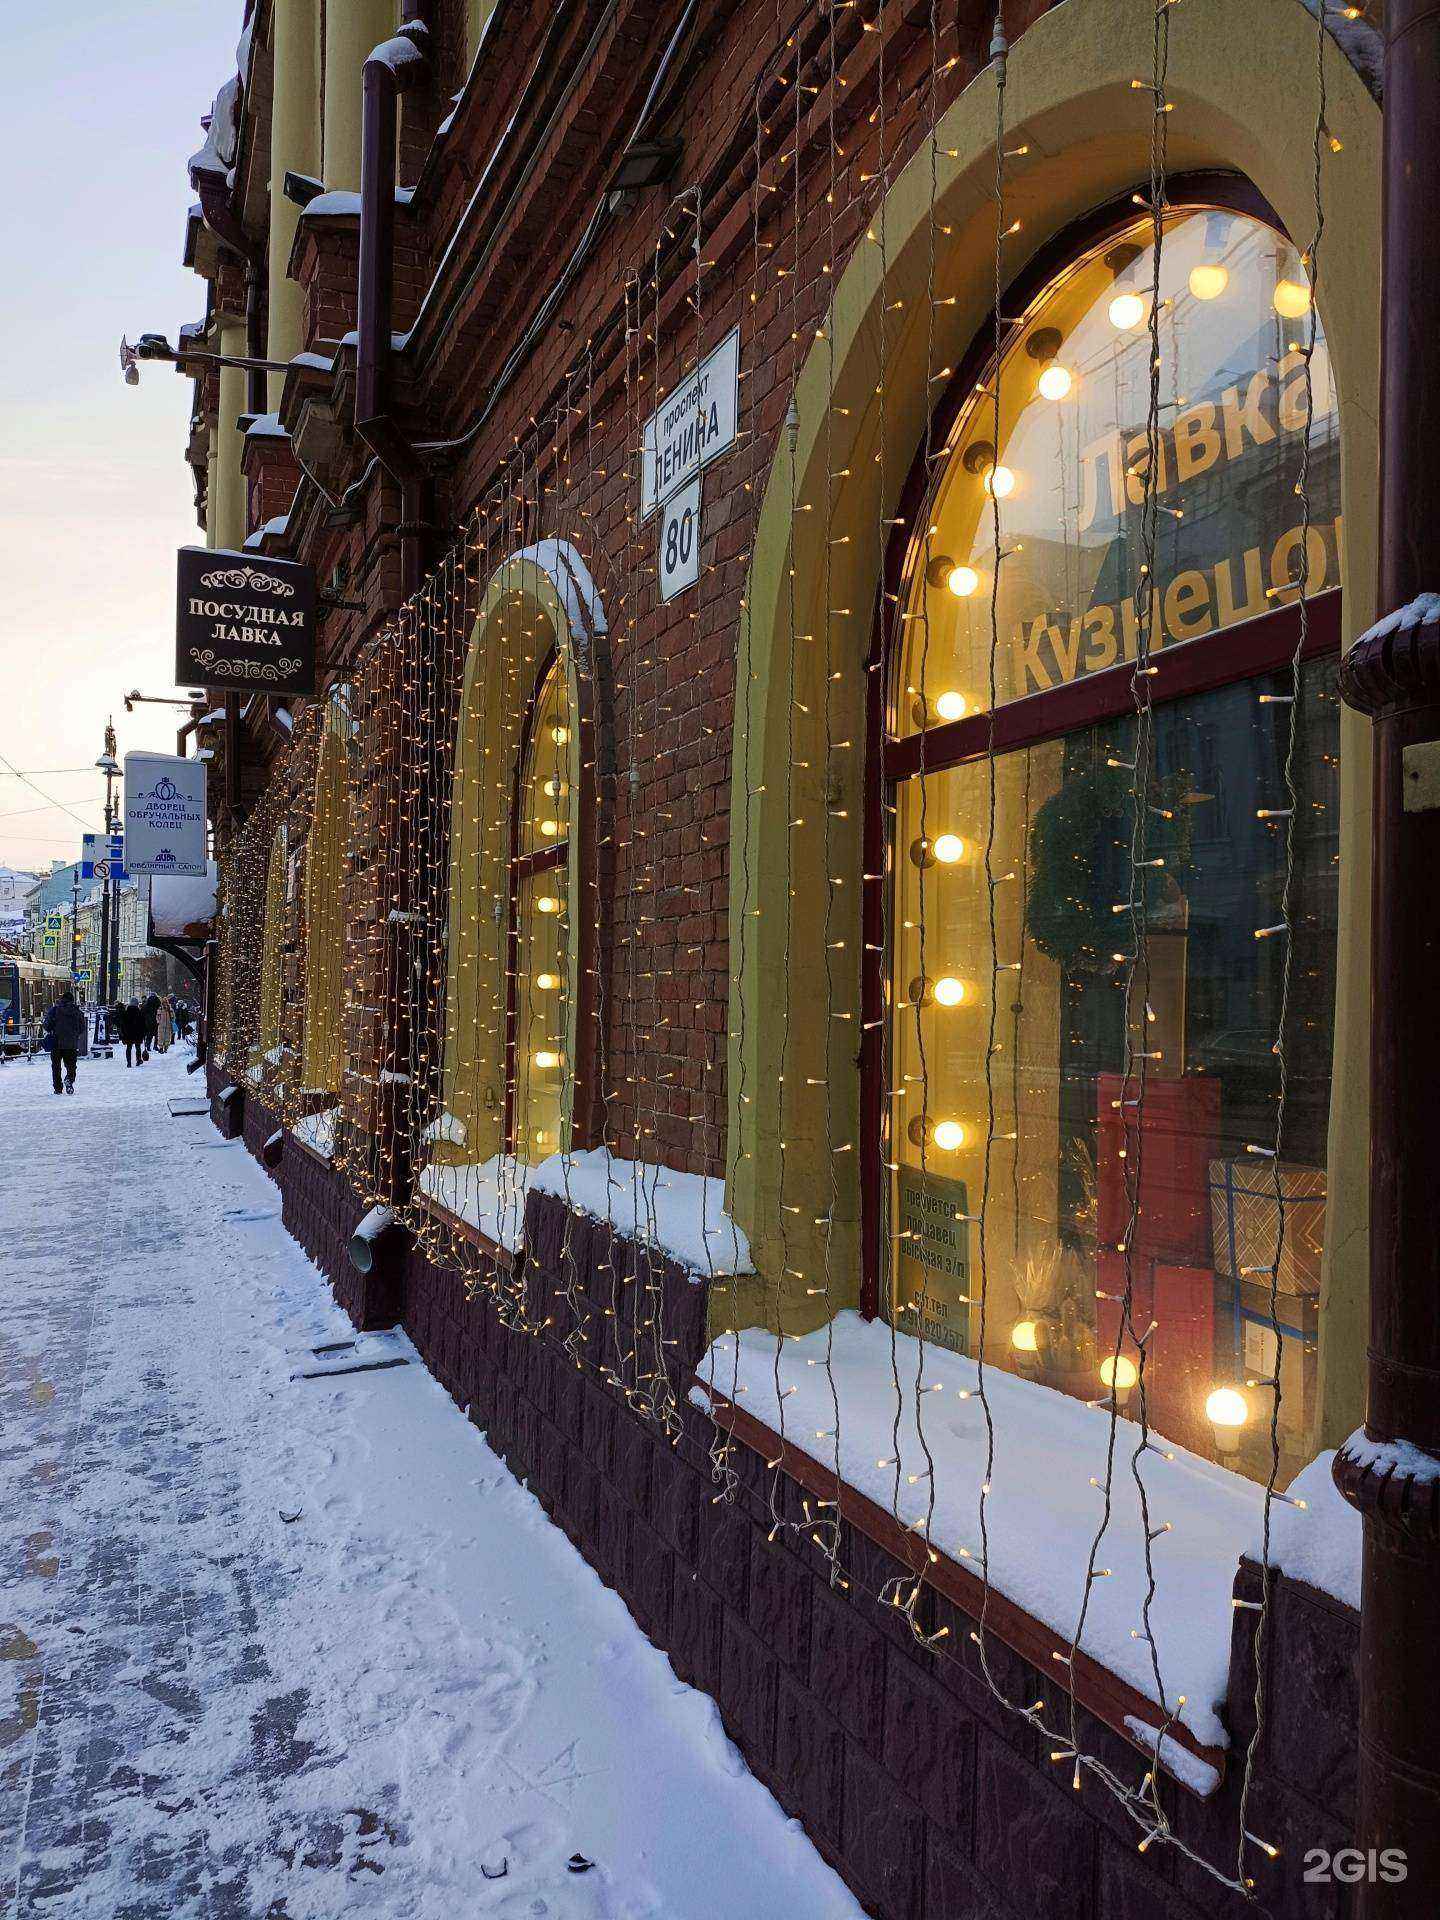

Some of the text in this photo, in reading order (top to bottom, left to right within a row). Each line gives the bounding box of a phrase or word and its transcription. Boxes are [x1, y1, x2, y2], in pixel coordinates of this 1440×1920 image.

[662, 371, 710, 437] проспект
[665, 507, 693, 575] 80
[188, 597, 305, 627] ПОСУДНАЯ
[211, 623, 283, 646] ЛАВКА
[128, 810, 201, 821] ОБРУЧАЛЬНЫХ
[145, 802, 186, 812] ДВОРЕЦ
[149, 820, 183, 830] КОЛЕЦ
